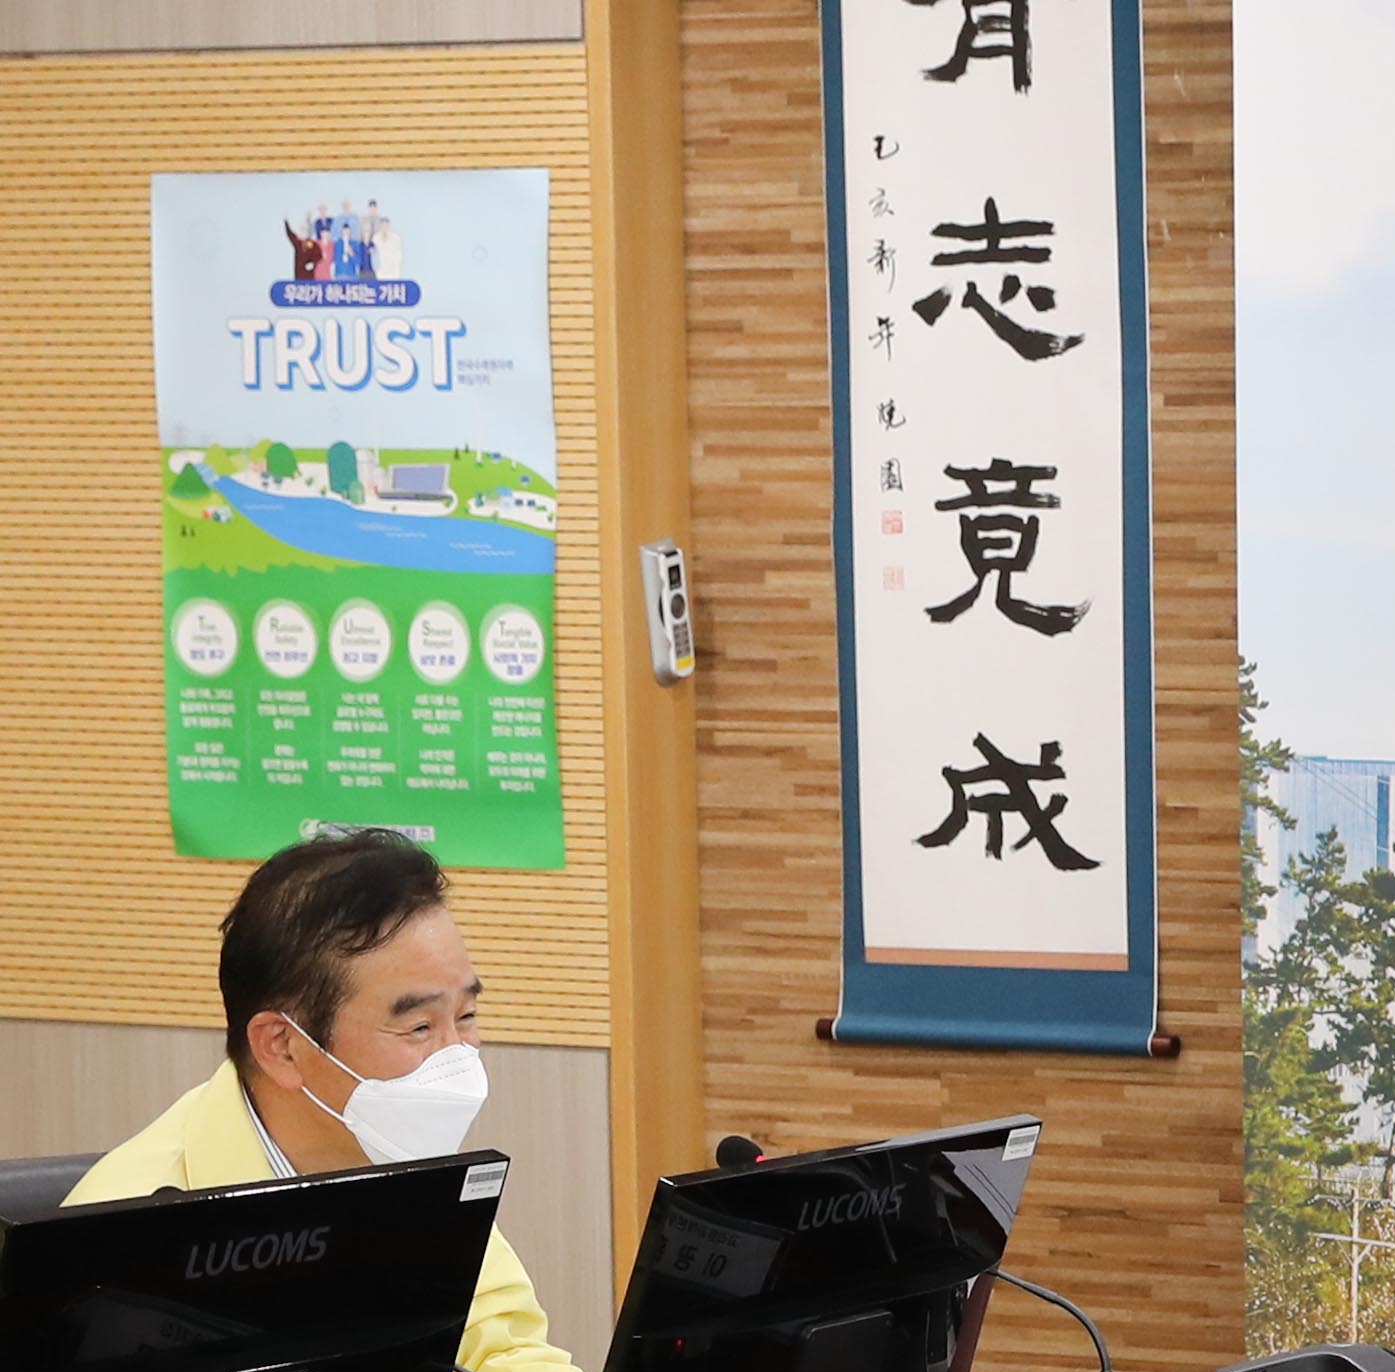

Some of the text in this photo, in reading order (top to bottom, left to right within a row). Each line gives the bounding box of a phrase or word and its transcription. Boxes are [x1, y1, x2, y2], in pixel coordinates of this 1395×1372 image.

[227, 317, 467, 392] TRUST
[797, 1184, 906, 1232] LUCOMS
[185, 1226, 331, 1279] LUCOMS
